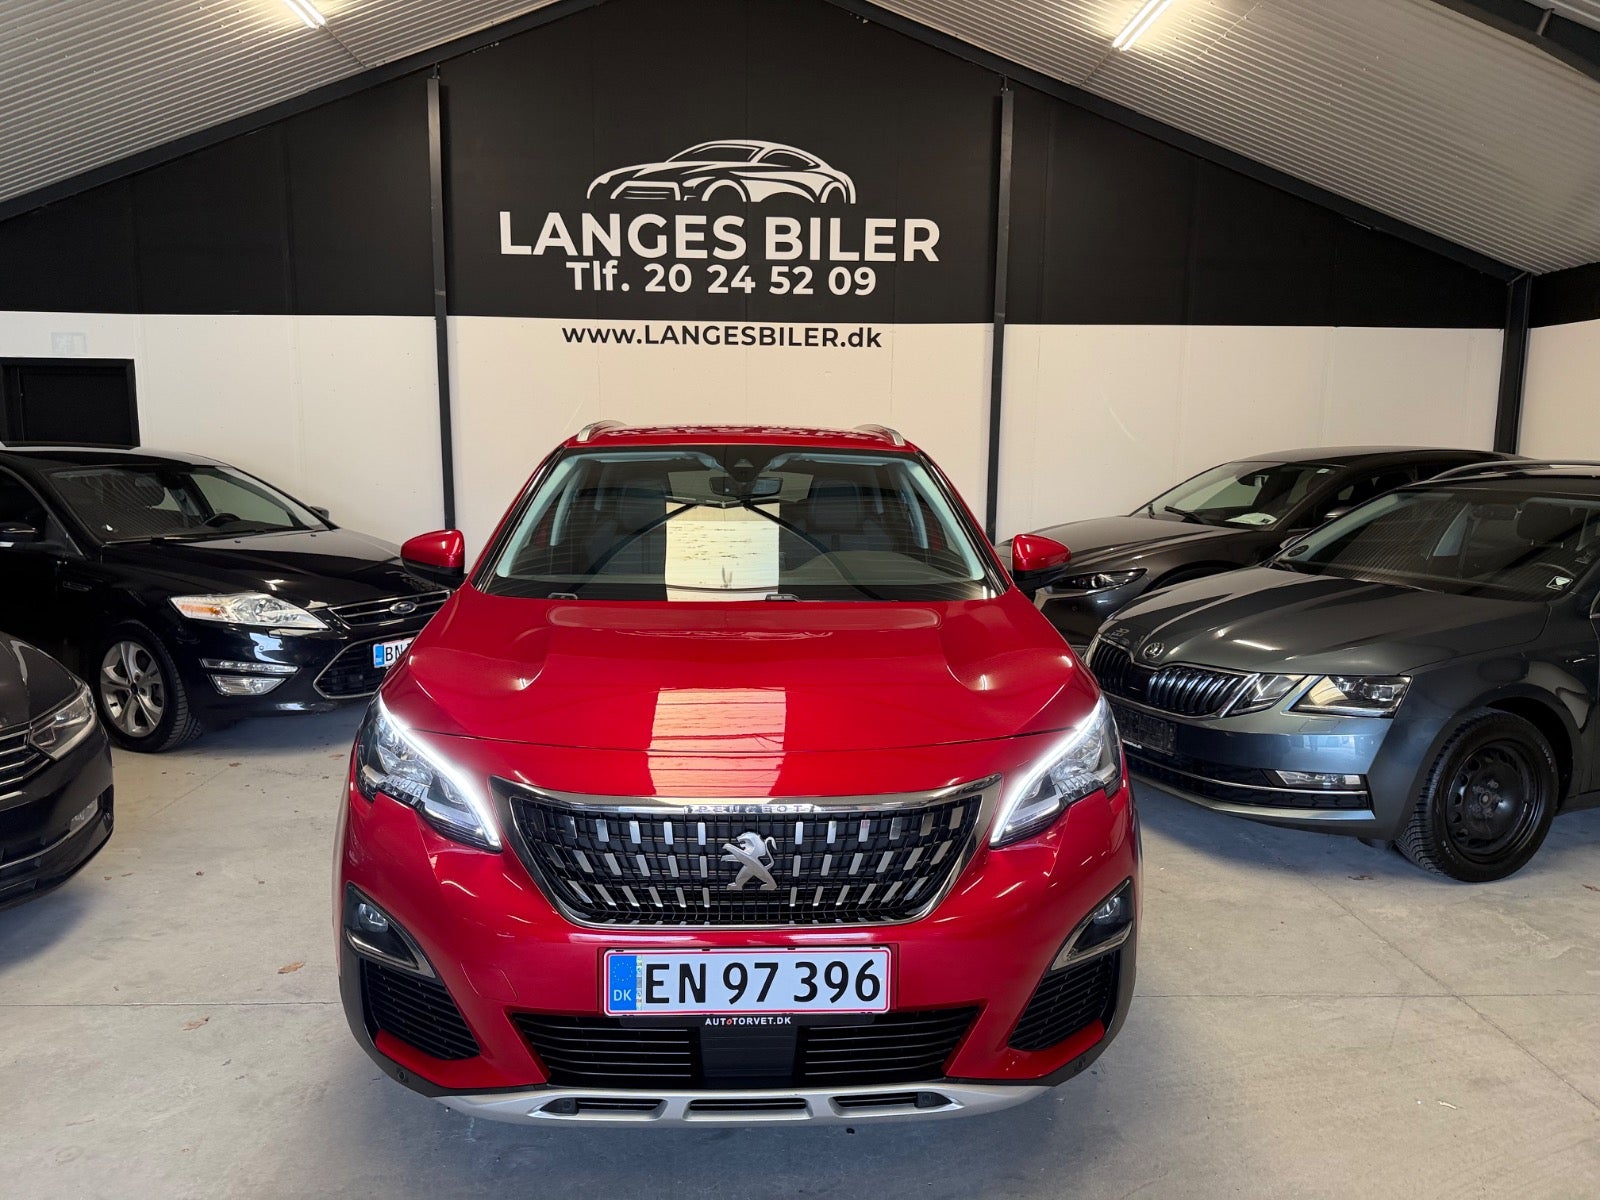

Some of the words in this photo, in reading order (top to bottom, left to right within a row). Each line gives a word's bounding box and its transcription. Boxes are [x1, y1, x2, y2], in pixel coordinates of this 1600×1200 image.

[499, 211, 747, 260] LANGES
[765, 216, 940, 262] BILER
[566, 260, 630, 292] Tlf.
[644, 262, 692, 293] 20
[707, 265, 756, 294] 24
[769, 266, 814, 295] 52
[829, 266, 877, 296] 09
[562, 325, 882, 348] www.LANGESBILER.dk
[613, 988, 632, 1002] DK
[645, 963, 707, 1004] EN
[722, 962, 779, 1005] 97
[793, 959, 881, 1004] 396
[704, 1016, 792, 1026] AUTOTORVET.DK
